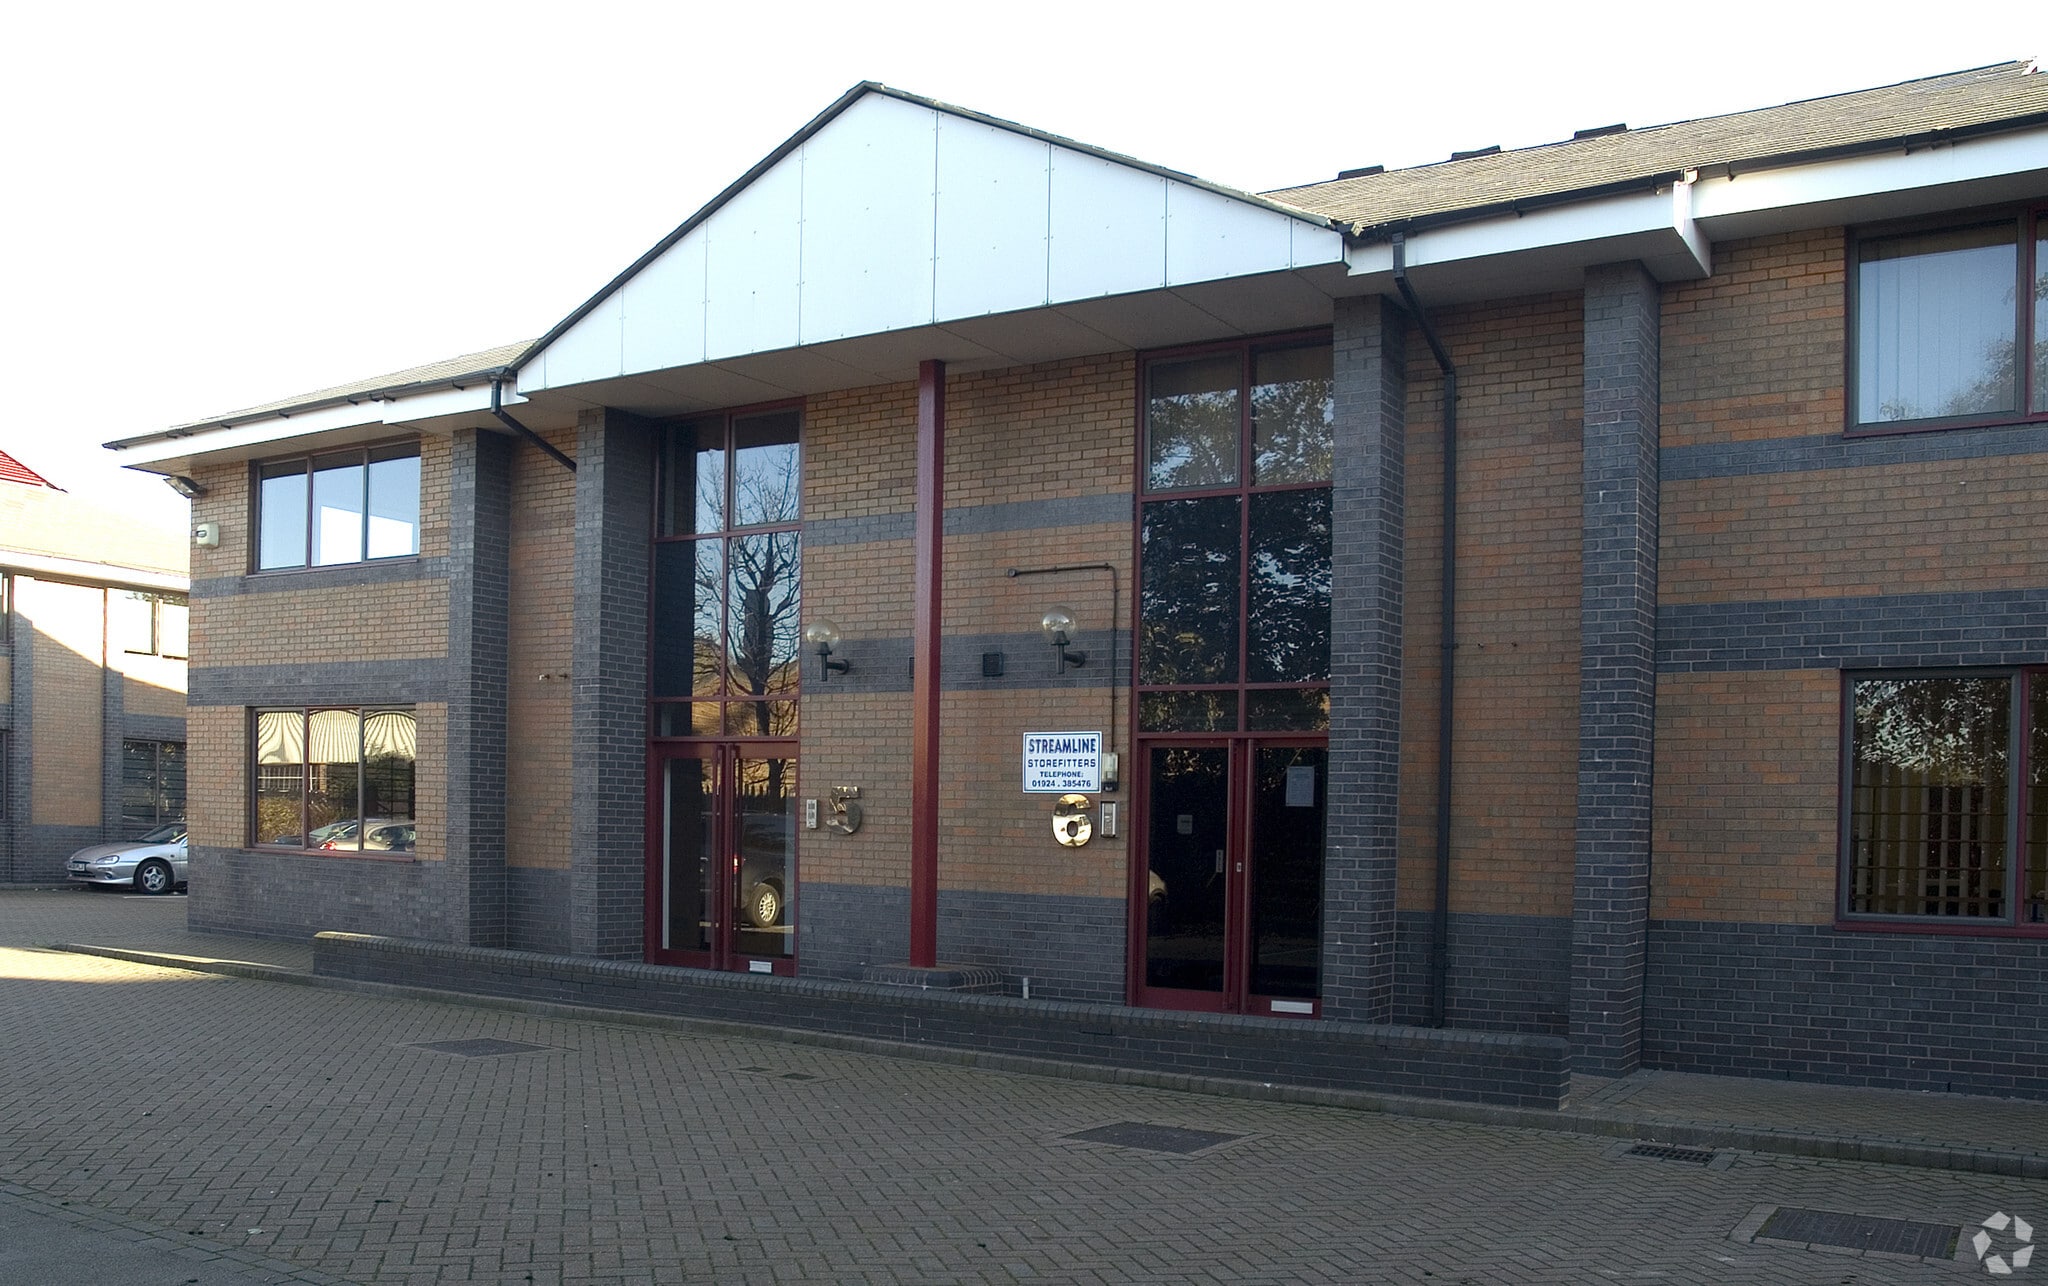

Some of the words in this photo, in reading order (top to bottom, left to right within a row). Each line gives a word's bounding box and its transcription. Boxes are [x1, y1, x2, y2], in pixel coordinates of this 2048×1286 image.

[1028, 738, 1096, 754] STREAMLINE
[1027, 759, 1096, 768] STOREFITTERS
[1032, 780, 1056, 788] 01924
[826, 785, 861, 835] 5
[1052, 793, 1092, 847] 6
